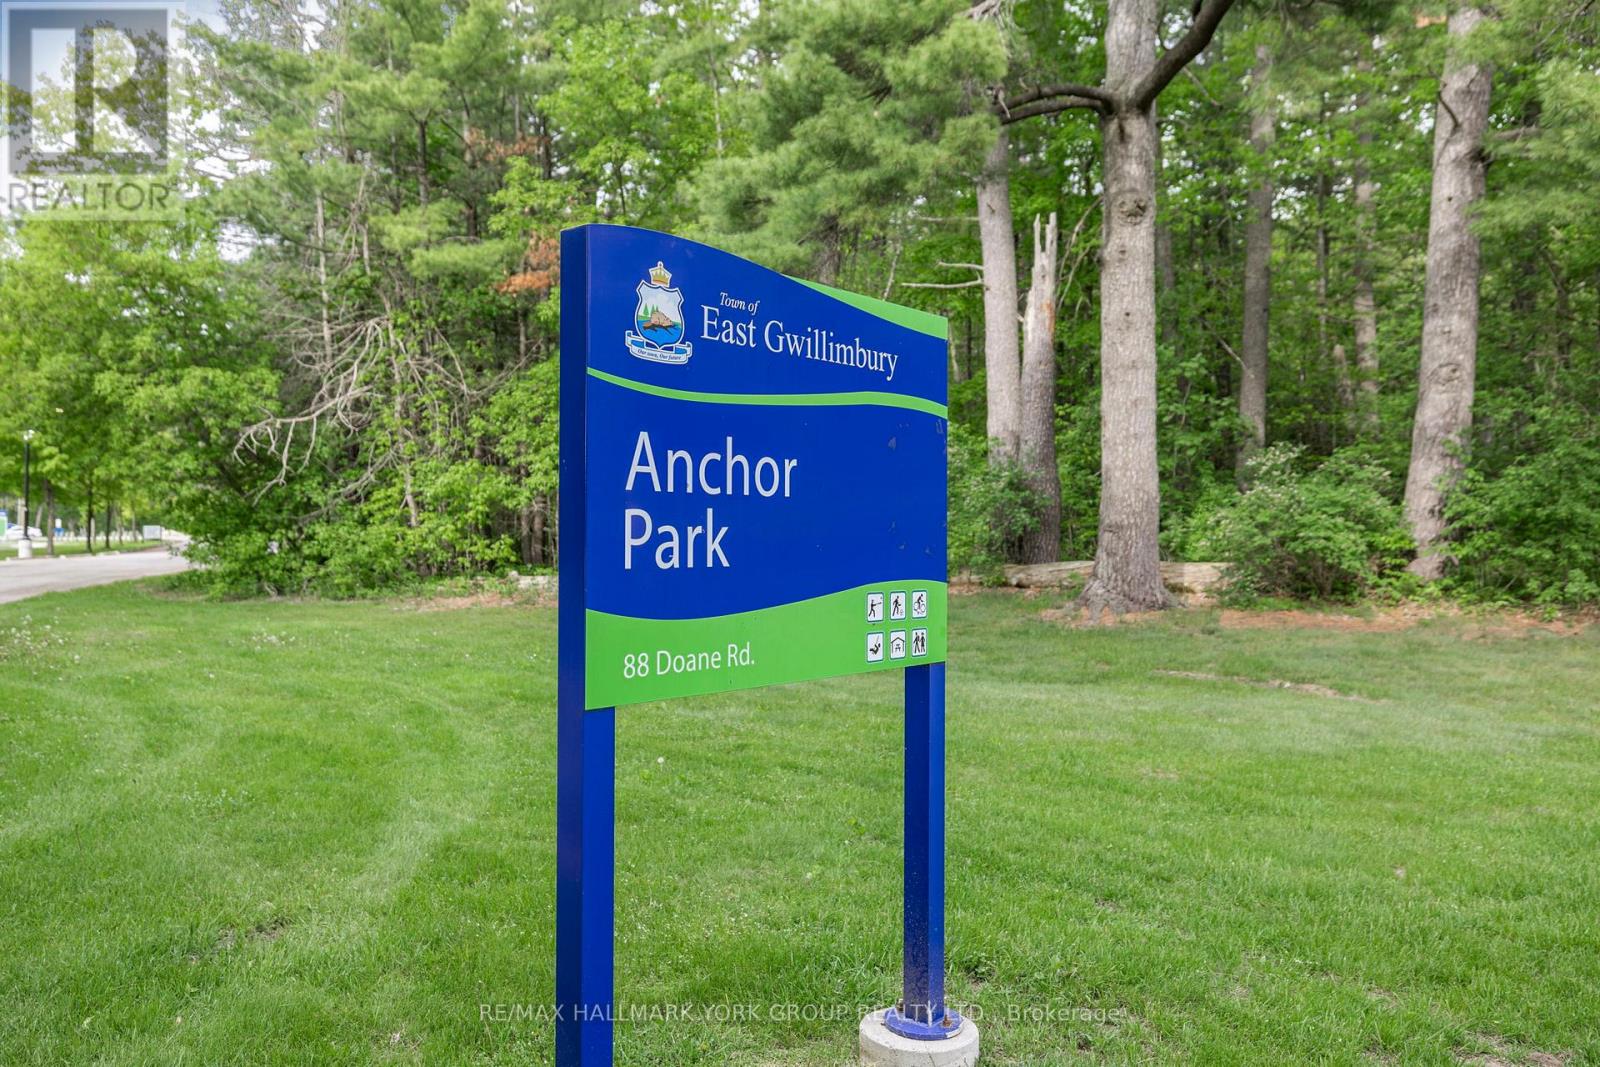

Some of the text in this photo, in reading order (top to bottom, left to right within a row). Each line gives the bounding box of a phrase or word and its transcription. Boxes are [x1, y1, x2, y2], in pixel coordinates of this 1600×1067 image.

[719, 292, 760, 314] Town of
[700, 304, 898, 381] East Gwillimbury
[625, 431, 797, 498] Anchor
[624, 508, 730, 570] Park
[623, 642, 755, 679] 88 Doane Rd.
